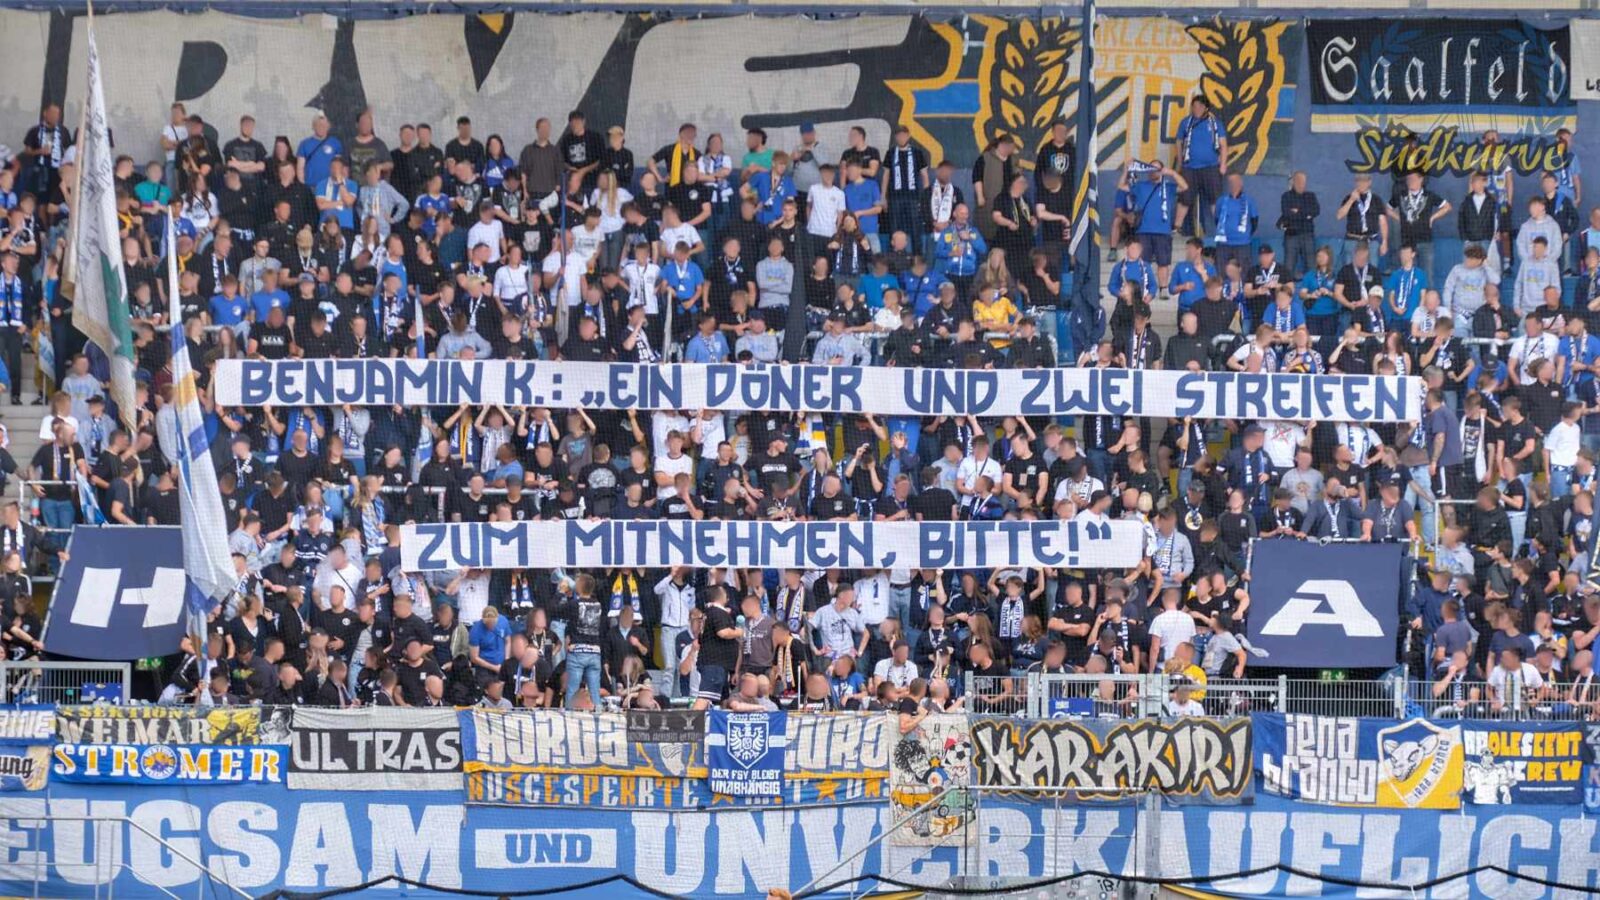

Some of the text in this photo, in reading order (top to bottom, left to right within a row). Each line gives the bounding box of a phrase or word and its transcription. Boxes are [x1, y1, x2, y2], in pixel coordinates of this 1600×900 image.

[1098, 54, 1173, 76] JENA
[1321, 36, 1567, 105] Saalfeld
[1142, 94, 1186, 144] FC
[1349, 124, 1572, 174] Südkurve
[240, 360, 484, 405] BENJAMIN
[706, 364, 863, 411] DÖNER
[904, 369, 998, 415] UND
[1020, 370, 1143, 416] ZWEI
[1175, 371, 1408, 420] STREIFEN
[414, 522, 529, 569] ZUM
[565, 521, 895, 568] MITNEHMEN,
[70, 566, 187, 628] H
[1260, 579, 1385, 638] A
[56, 716, 214, 745] WEIMAR
[291, 730, 461, 772] ULTRAS
[711, 768, 729, 780] DER
[751, 768, 781, 780] BLEIBT
[711, 780, 781, 796] UNABHÄNGIG
[504, 832, 593, 865] UND
